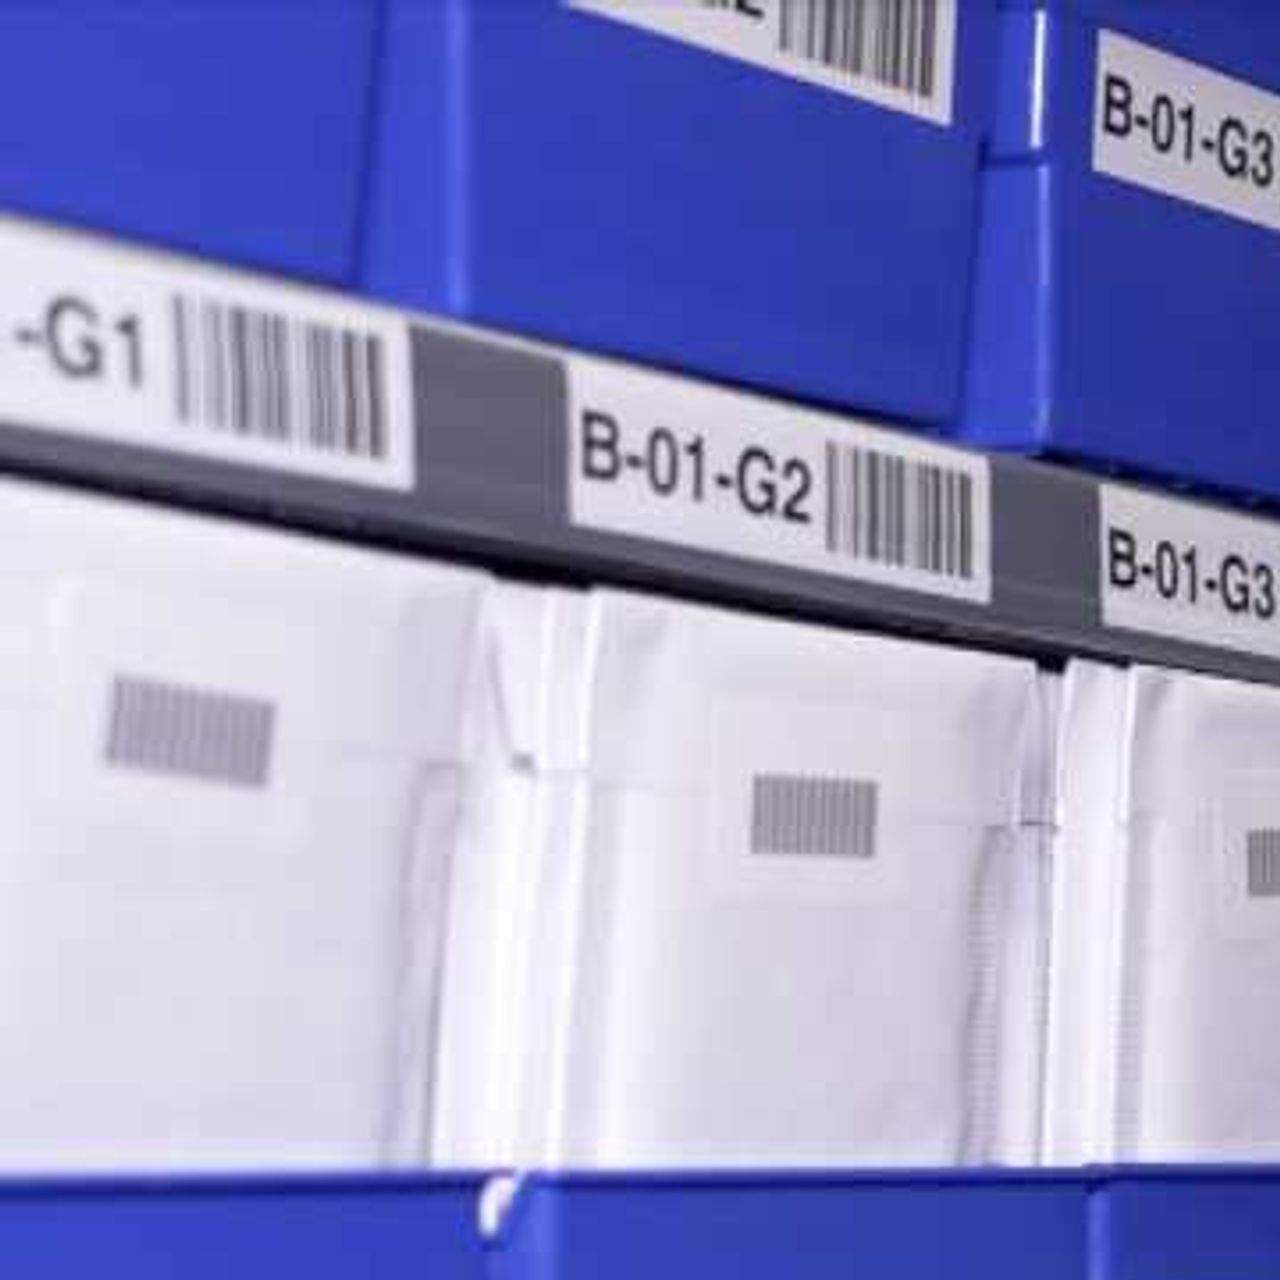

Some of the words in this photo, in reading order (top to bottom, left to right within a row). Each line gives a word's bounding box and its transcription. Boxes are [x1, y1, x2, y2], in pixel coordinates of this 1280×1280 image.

[1101, 73, 1274, 188] B-01-G3
[581, 409, 813, 525] B-01-G2
[1108, 527, 1276, 621] B-01-G3
